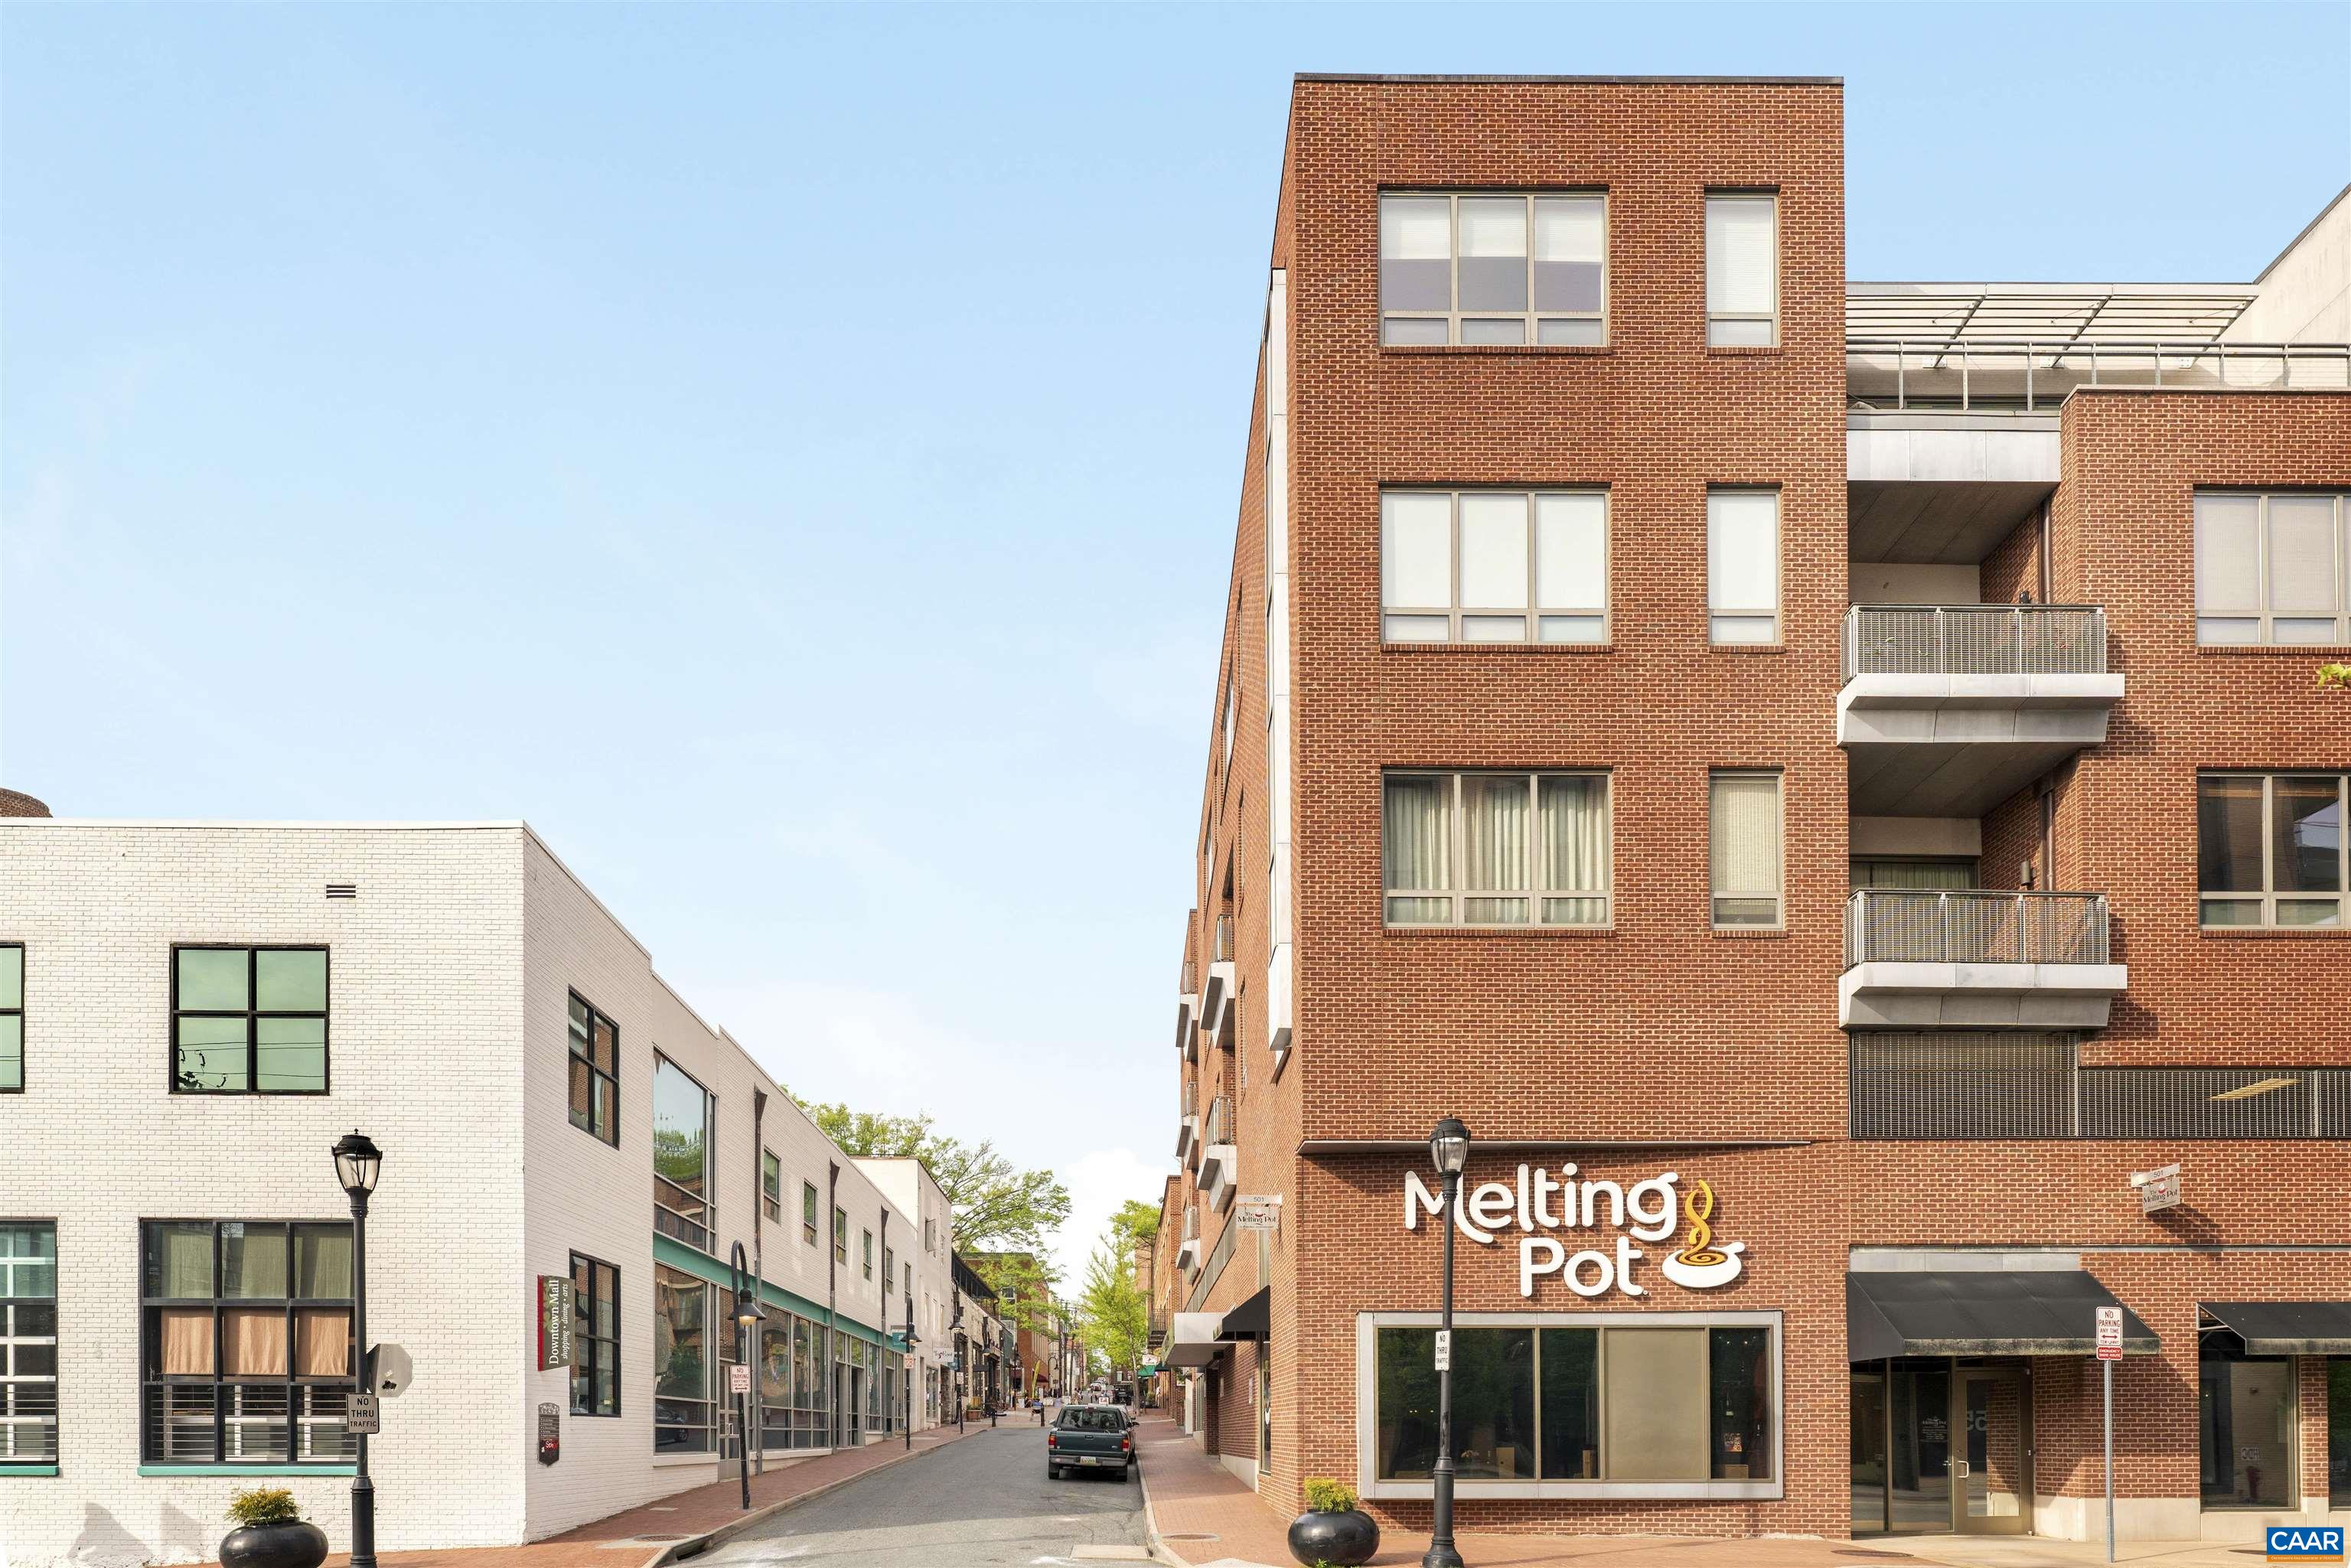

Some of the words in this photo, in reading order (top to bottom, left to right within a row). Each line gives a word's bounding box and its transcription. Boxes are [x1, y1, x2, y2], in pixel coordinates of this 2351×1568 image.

[2154, 1169, 2164, 1178] 501
[1405, 1162, 1678, 1244] Melting
[2144, 1194, 2166, 1205] Melting
[2167, 1189, 2177, 1198] Pot
[1519, 1236, 1644, 1298] Pot
[549, 1280, 559, 1305] Mall
[561, 1303, 569, 1324] dining
[2098, 1319, 2121, 1328] PARKING
[549, 1307, 559, 1364] Downtown
[561, 1330, 569, 1359] shopping
[1440, 1335, 1446, 1343] NO
[1436, 1346, 1448, 1354] THRU
[357, 1397, 369, 1406] NO
